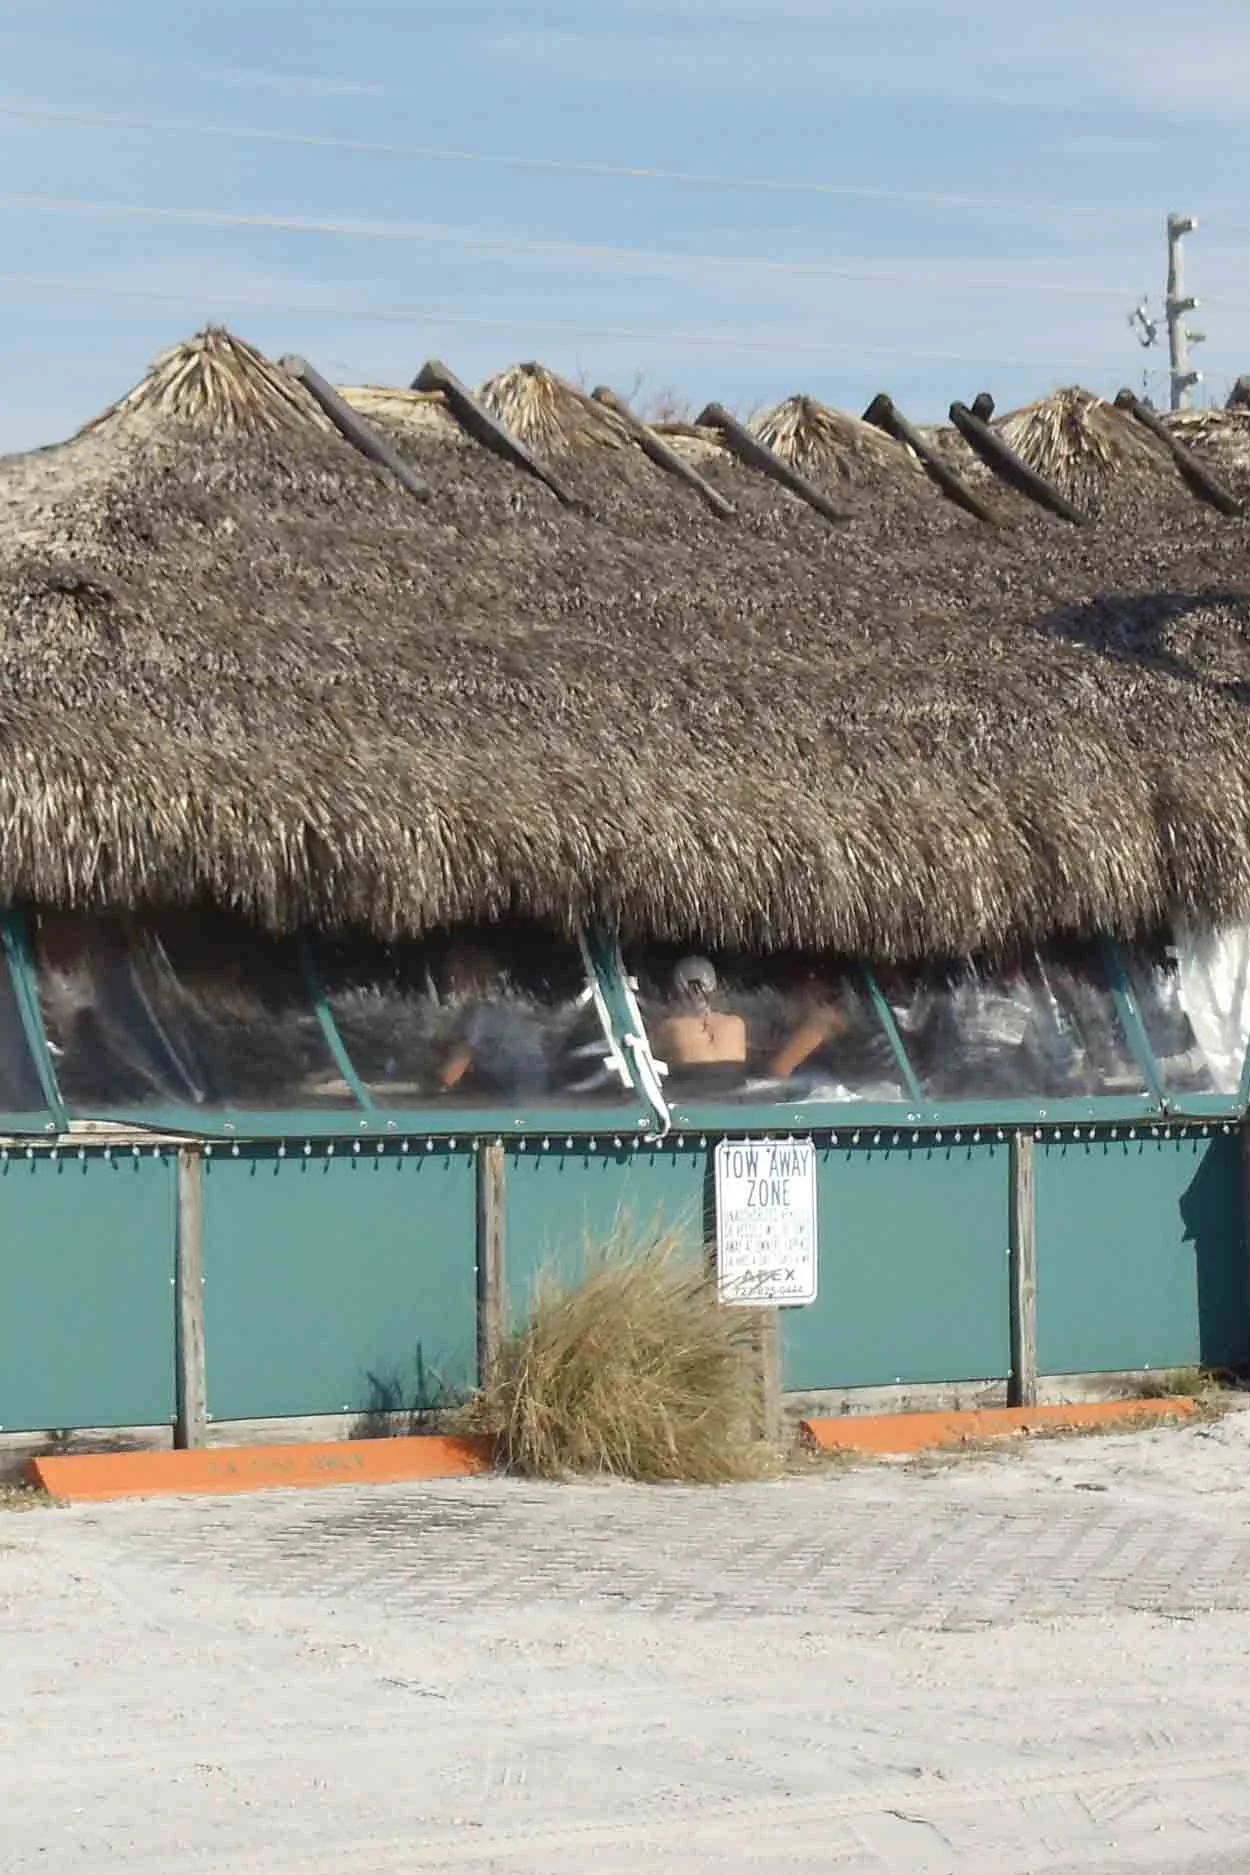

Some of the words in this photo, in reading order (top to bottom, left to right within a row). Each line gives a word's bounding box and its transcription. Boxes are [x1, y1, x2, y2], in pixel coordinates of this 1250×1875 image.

[723, 1150, 759, 1178] TOW
[768, 1149, 809, 1177] AWAY
[746, 1178, 791, 1207] ZONE
[742, 1268, 796, 1281] APEX
